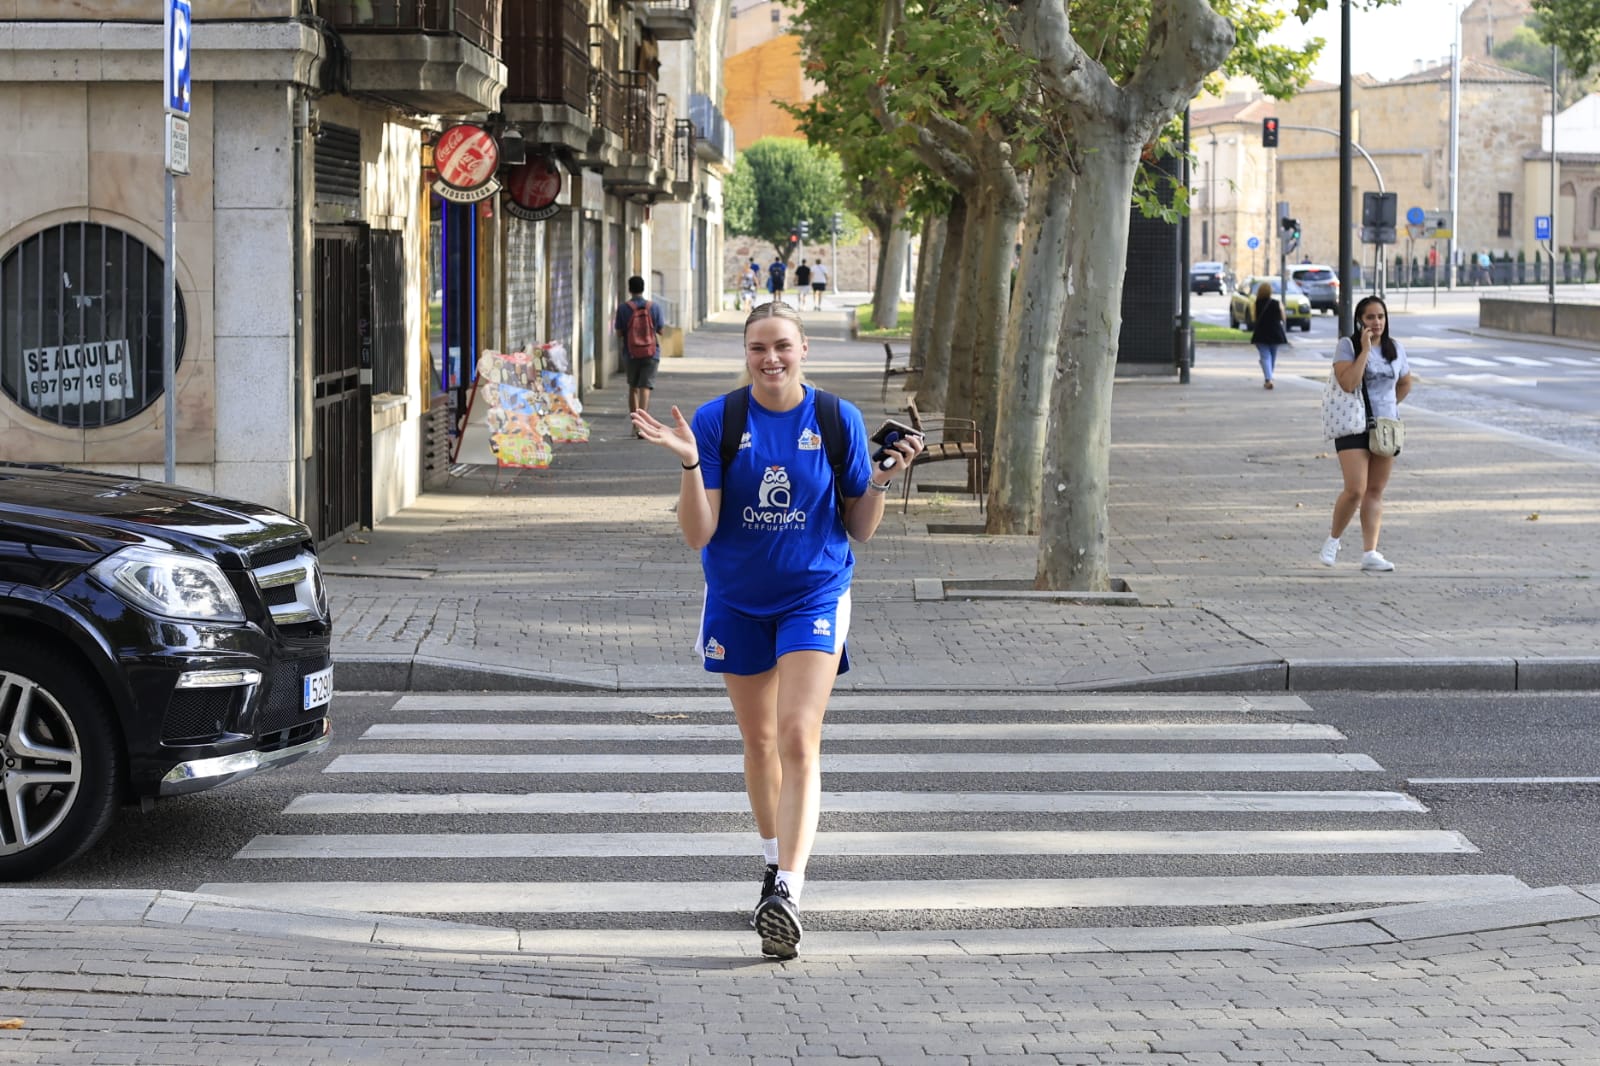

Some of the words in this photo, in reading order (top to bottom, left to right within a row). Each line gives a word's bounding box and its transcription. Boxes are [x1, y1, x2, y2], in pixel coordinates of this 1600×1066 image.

[174, 8, 187, 97] P
[28, 352, 49, 373] SE
[31, 380, 57, 394] 697
[63, 377, 80, 391] 97
[86, 374, 102, 389] 19
